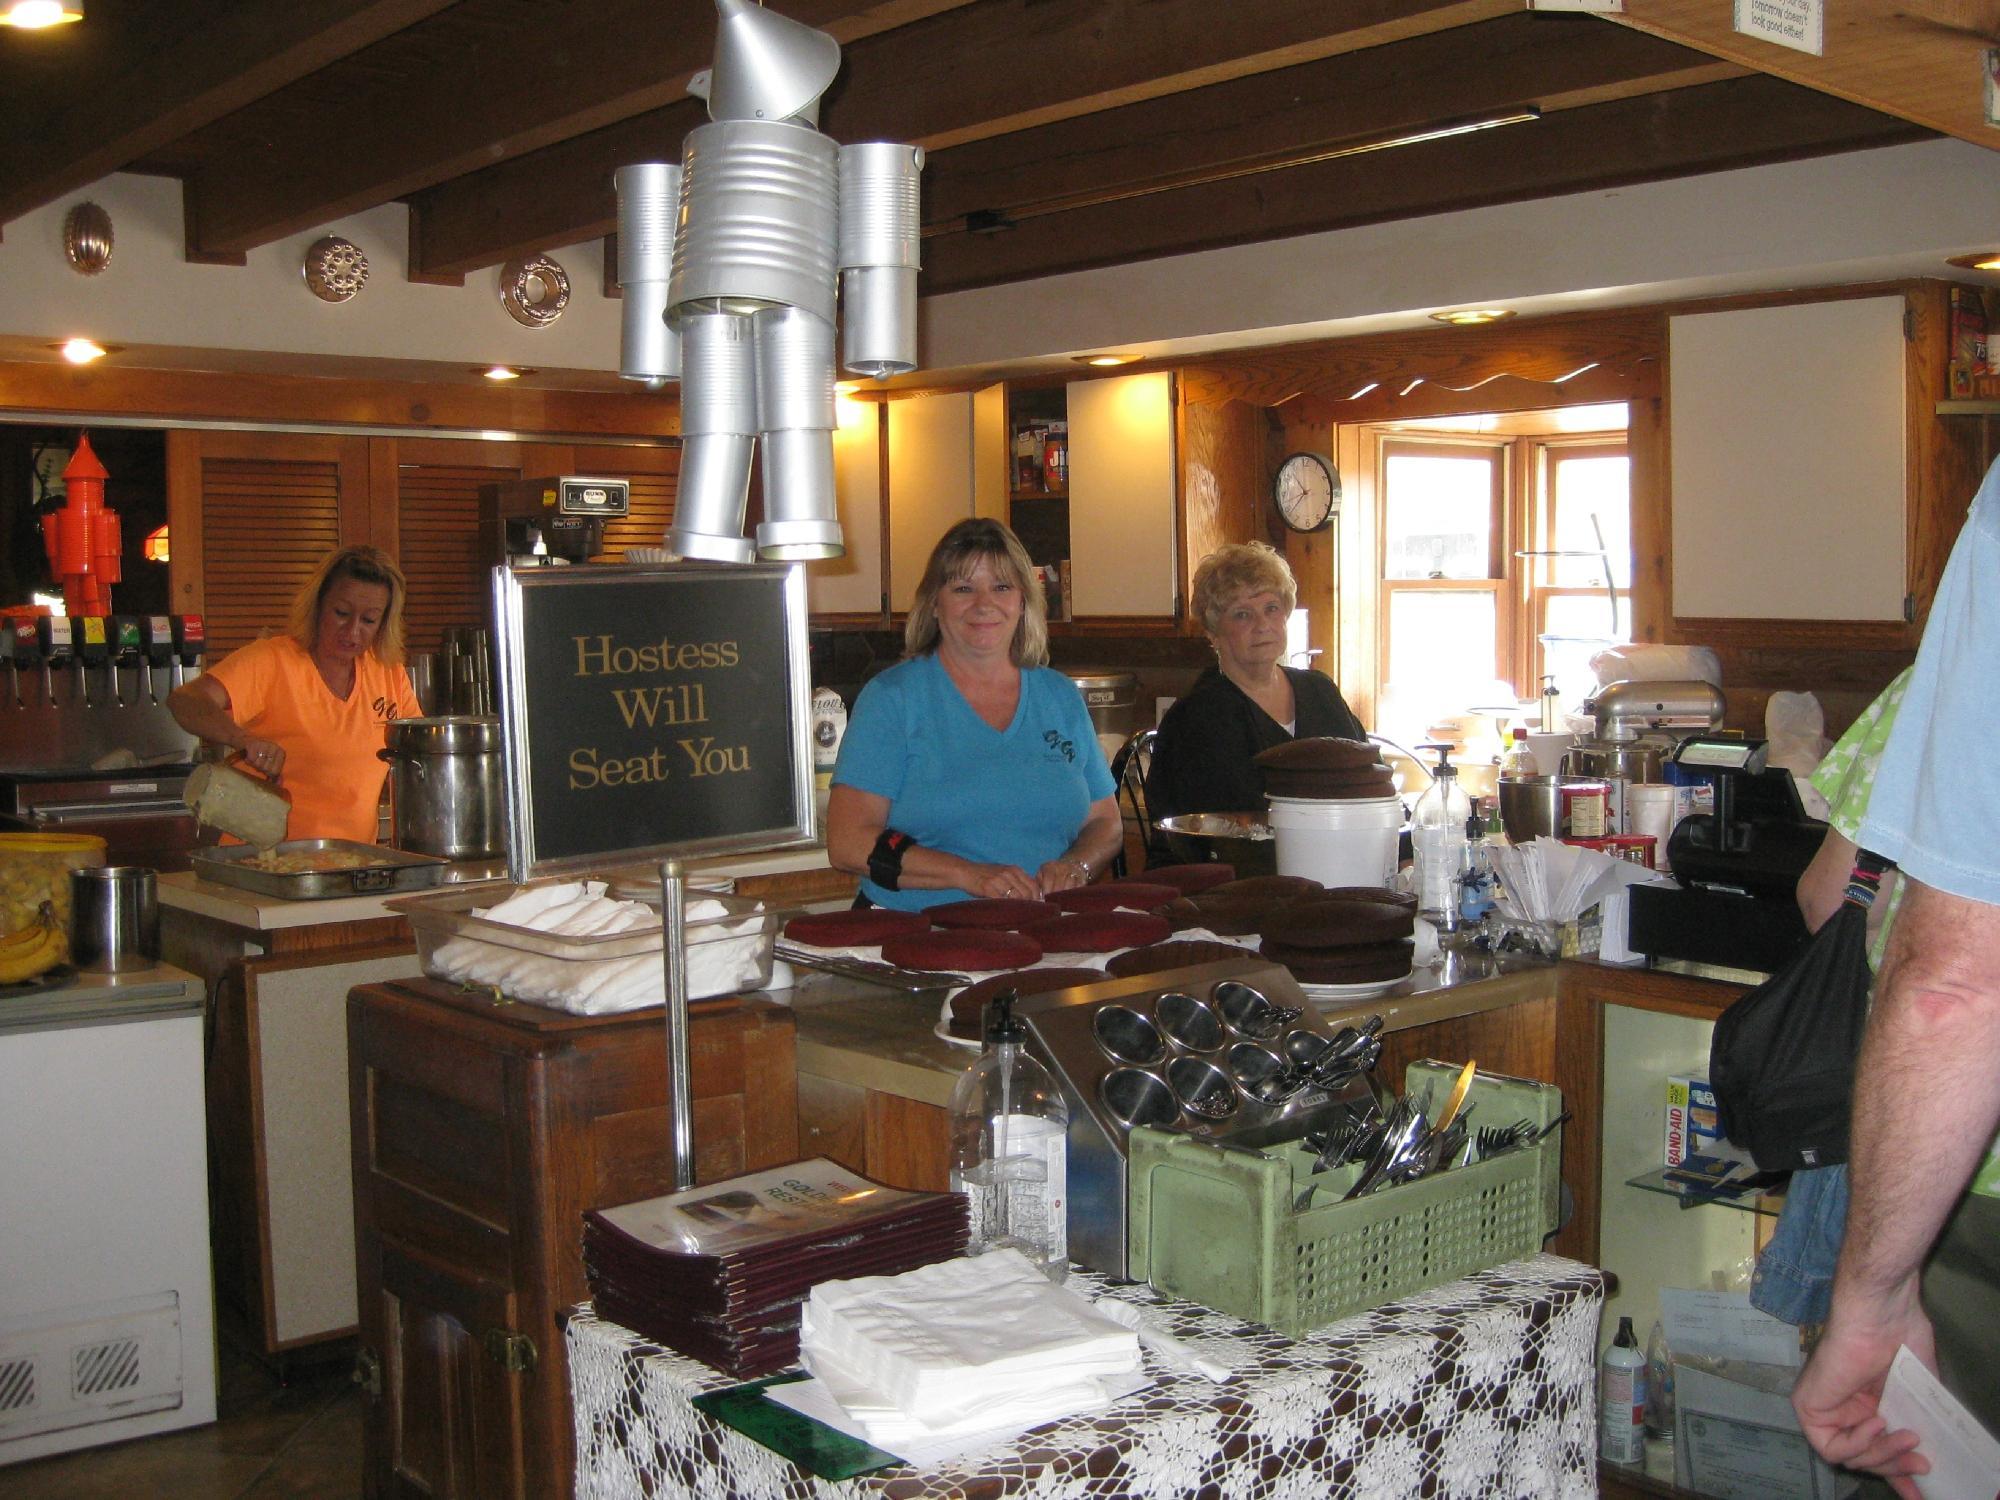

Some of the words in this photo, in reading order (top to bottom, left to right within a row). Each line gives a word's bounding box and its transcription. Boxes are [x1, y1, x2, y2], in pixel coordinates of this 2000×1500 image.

[1751, 11, 1766, 29] look
[1766, 19, 1783, 34] good
[1783, 24, 1804, 41] either!
[1784, 9, 1808, 26] doesn't
[572, 634, 739, 677] Hostess
[611, 683, 709, 729] Will
[569, 747, 670, 791] Seat
[676, 737, 752, 777] You
[1668, 1108, 1682, 1165] BAND-AID
